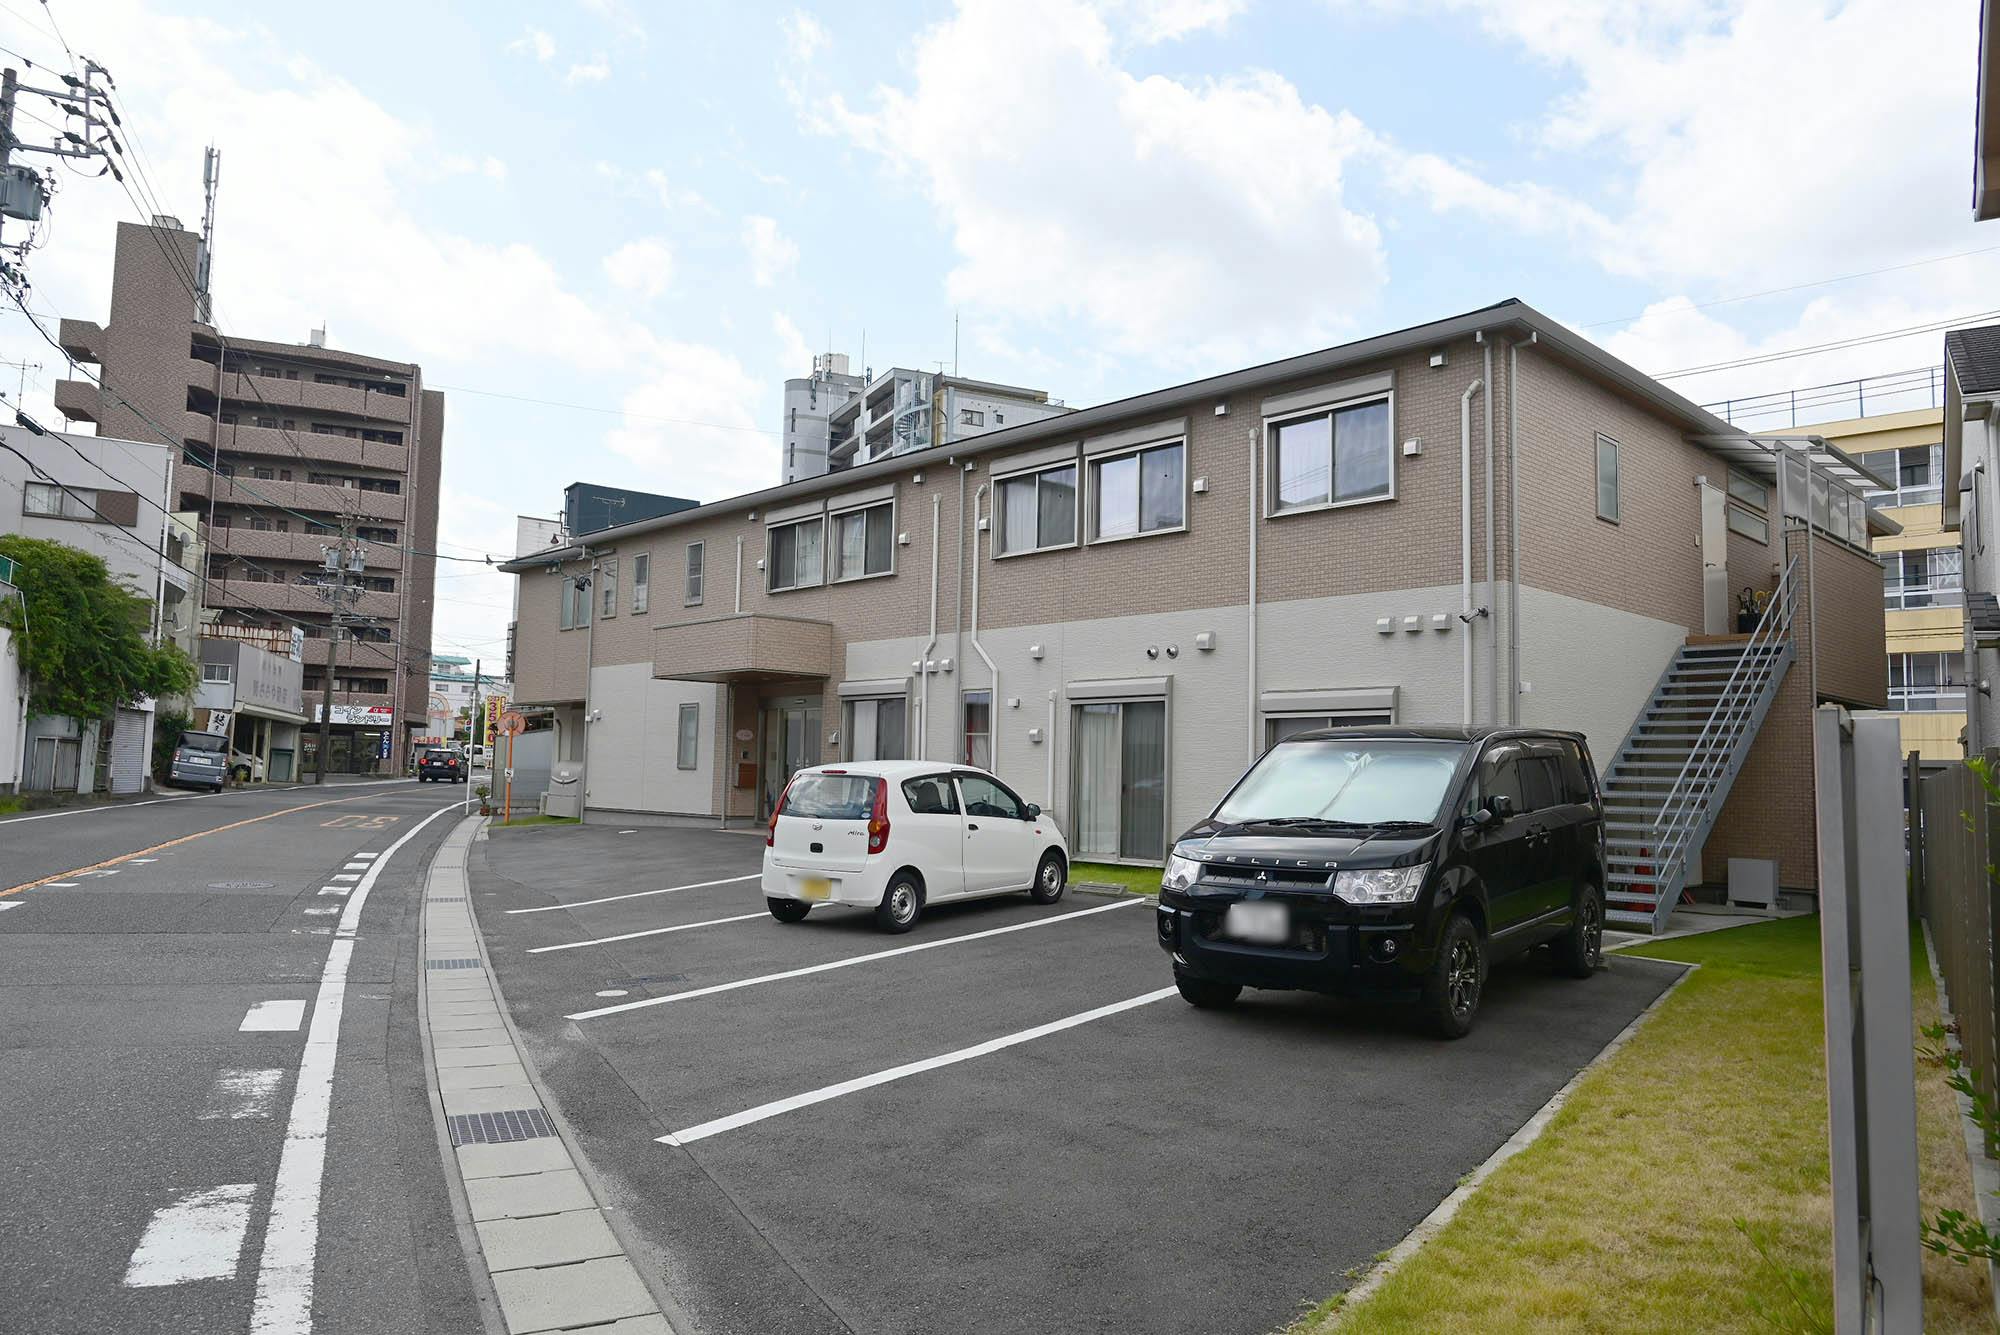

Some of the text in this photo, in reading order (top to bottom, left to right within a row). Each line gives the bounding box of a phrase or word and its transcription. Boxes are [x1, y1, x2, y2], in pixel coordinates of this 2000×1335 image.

[334, 705, 363, 715] コイン
[346, 713, 390, 724] ランドリー
[1202, 854, 1338, 868] DELICA
